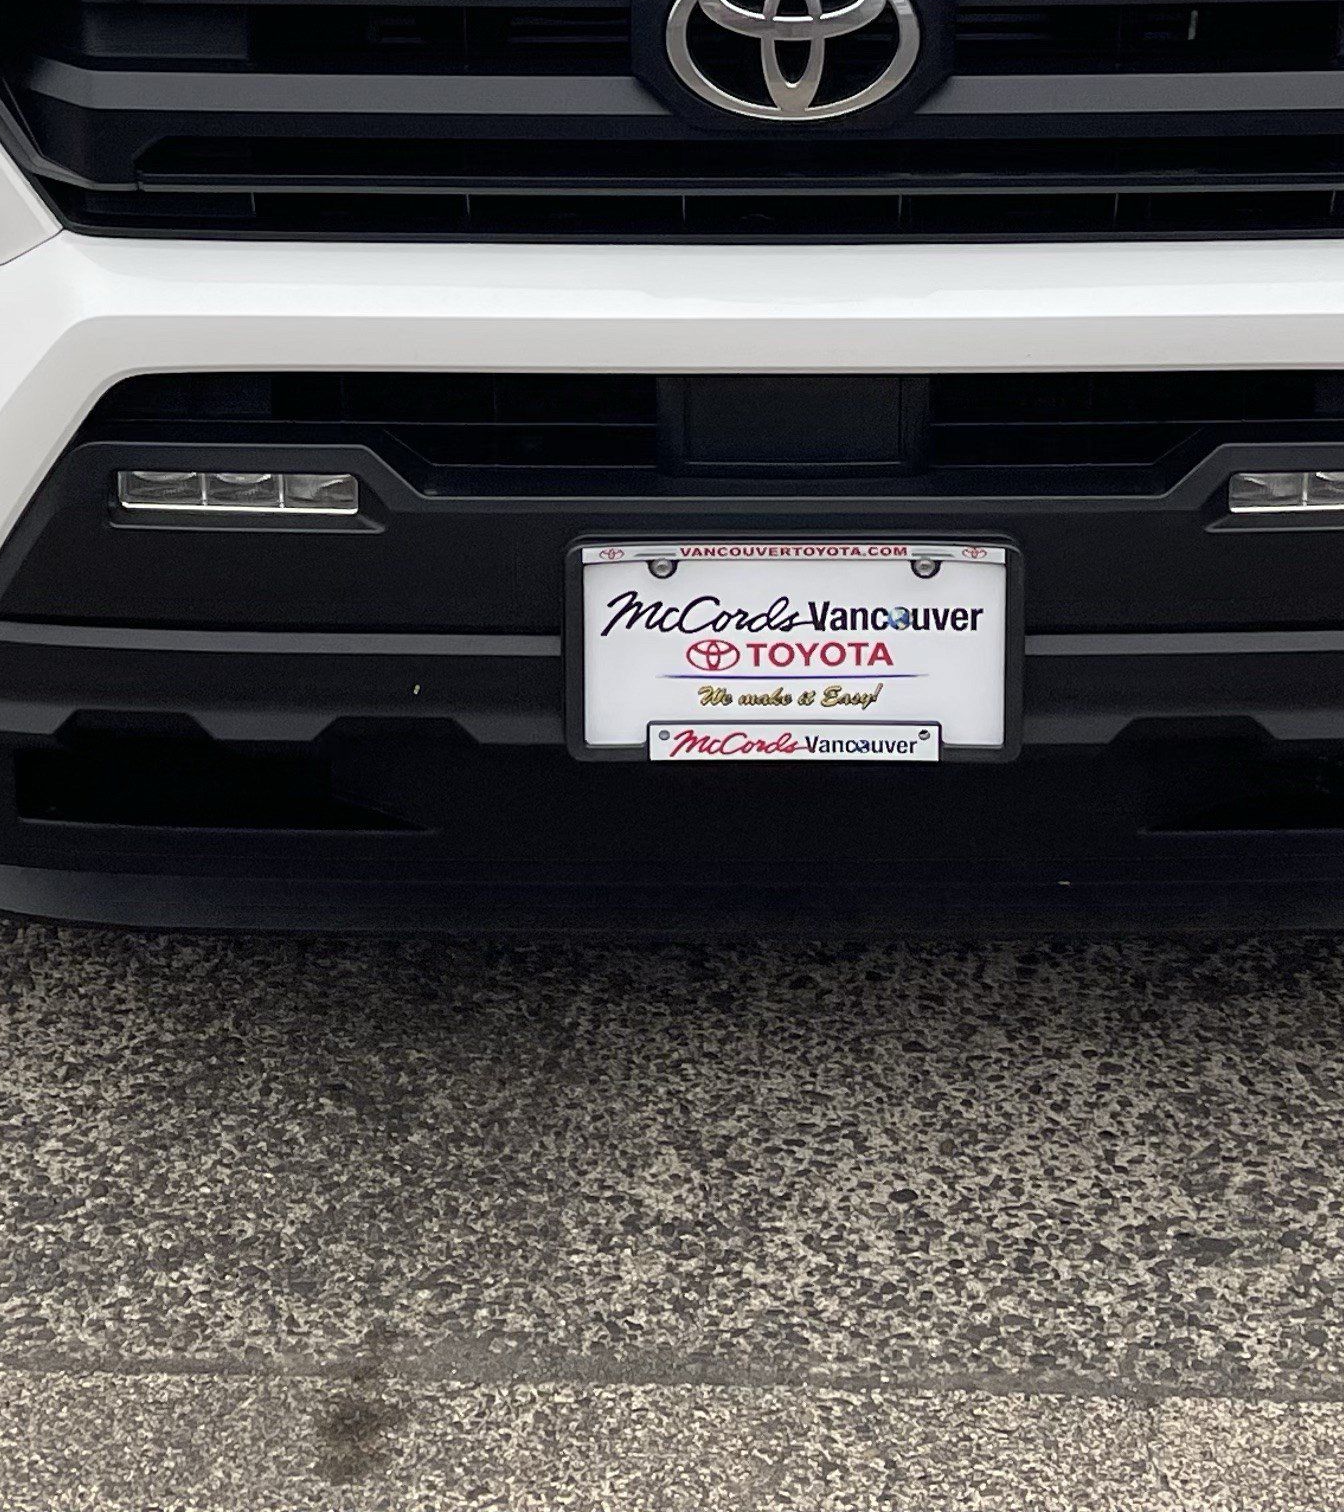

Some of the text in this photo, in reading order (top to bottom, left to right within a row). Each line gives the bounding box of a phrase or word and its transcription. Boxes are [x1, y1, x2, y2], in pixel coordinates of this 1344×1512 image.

[679, 546, 908, 558] VANCOUVERTOYOTA.COM
[746, 641, 894, 668] TOYOTA
[697, 682, 884, 711] We make it Easy!
